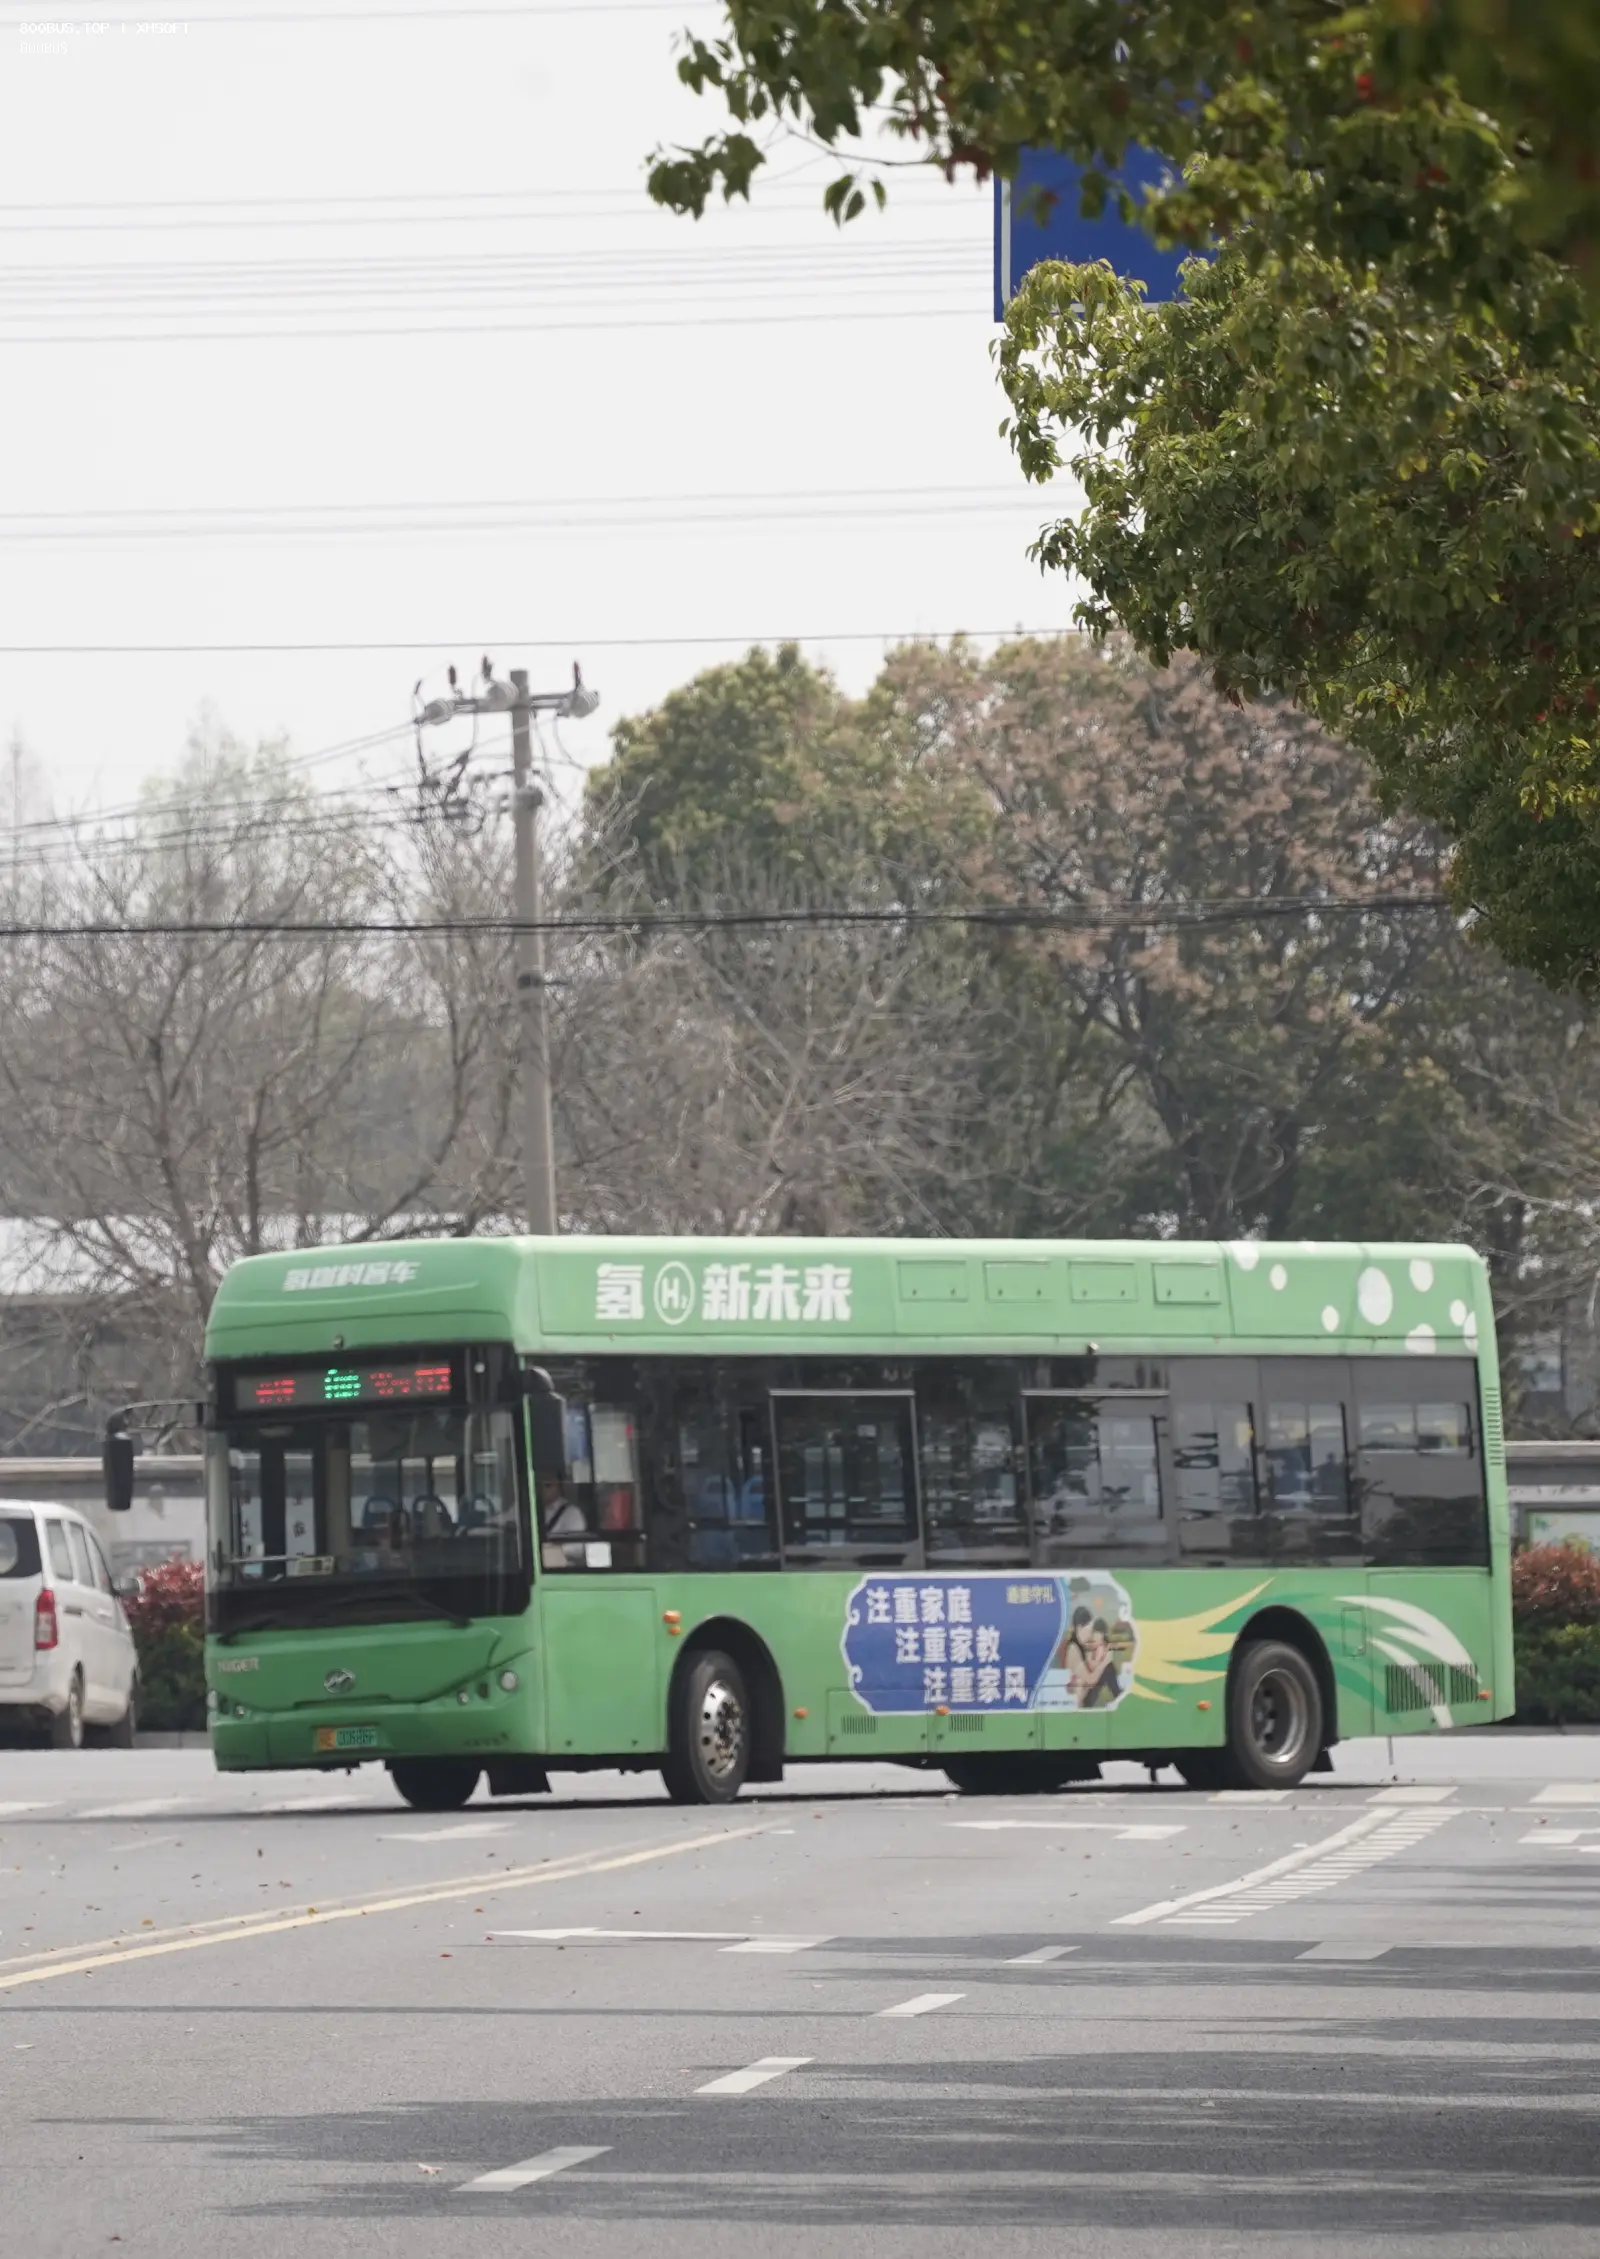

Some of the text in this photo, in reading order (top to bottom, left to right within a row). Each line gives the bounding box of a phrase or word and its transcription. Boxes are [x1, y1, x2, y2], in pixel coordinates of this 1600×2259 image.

[595, 1262, 645, 1319] 氢
[702, 1262, 852, 1321] 新未来
[866, 1585, 973, 1624] 注重家庭
[895, 1624, 1001, 1664] 注重家教
[923, 1665, 1029, 1704] 注重家风
